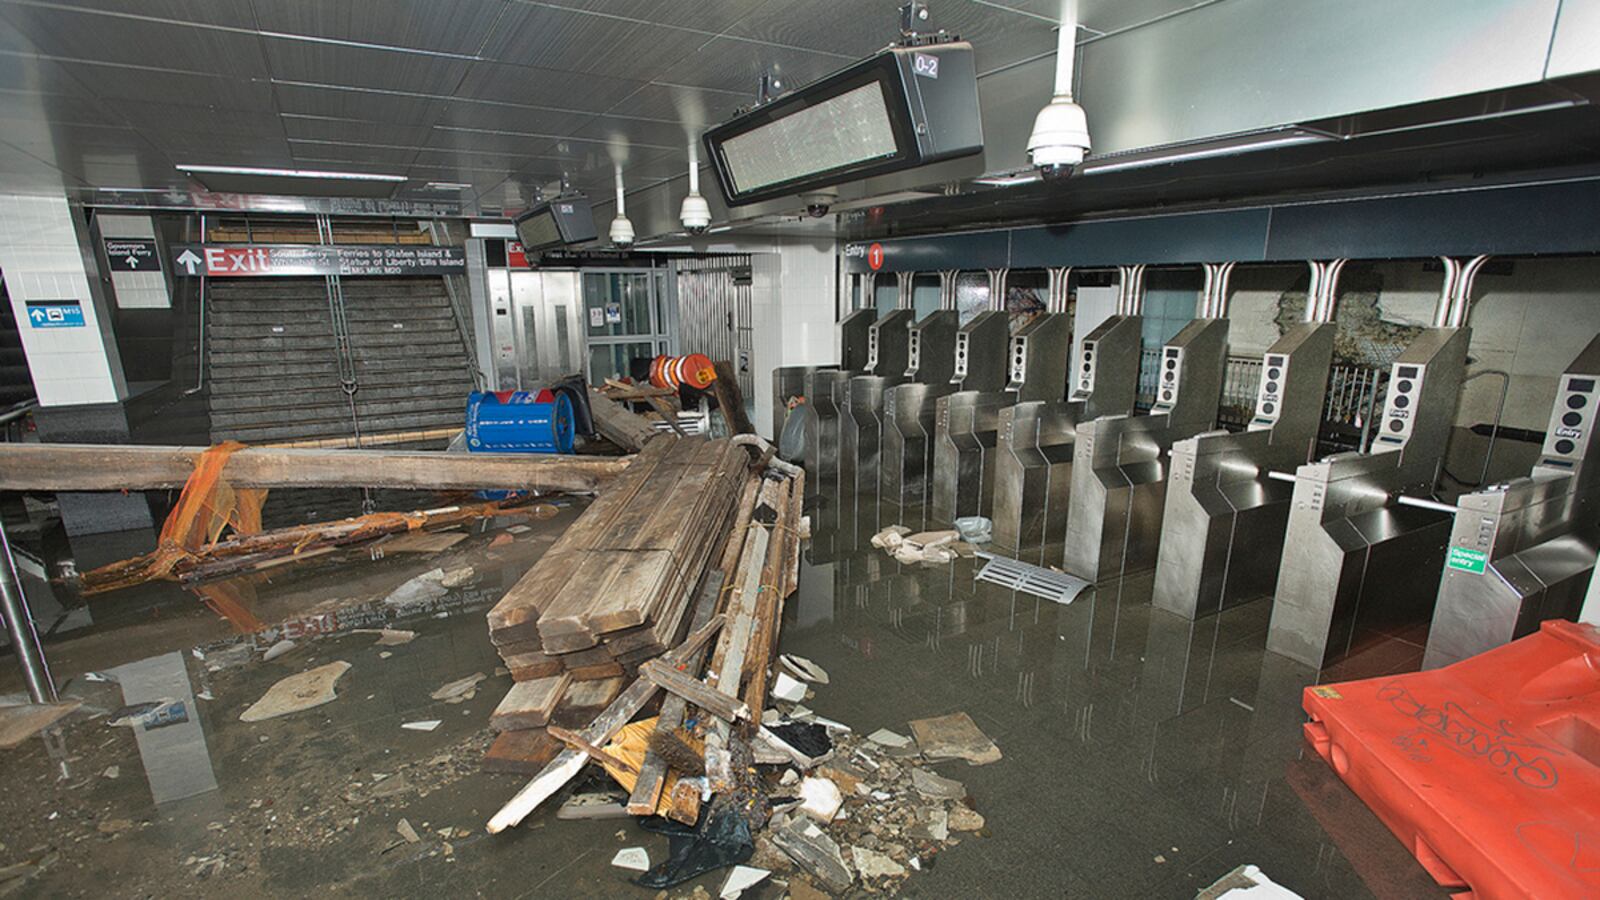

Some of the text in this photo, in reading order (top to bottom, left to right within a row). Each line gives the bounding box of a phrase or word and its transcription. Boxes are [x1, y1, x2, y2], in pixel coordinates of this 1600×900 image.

[916, 55, 937, 75] 0-2
[132, 249, 152, 257] Ferry
[336, 249, 452, 258] Ferries to Staten Island &
[846, 244, 866, 258] Entry
[205, 248, 270, 272] Exit
[339, 258, 370, 266] Statue
[373, 258, 383, 266] of
[386, 258, 416, 267] Liberty
[439, 259, 465, 267] Island
[1555, 427, 1581, 439] Entry
[1453, 549, 1485, 561] Special
[1452, 558, 1474, 567] entry
